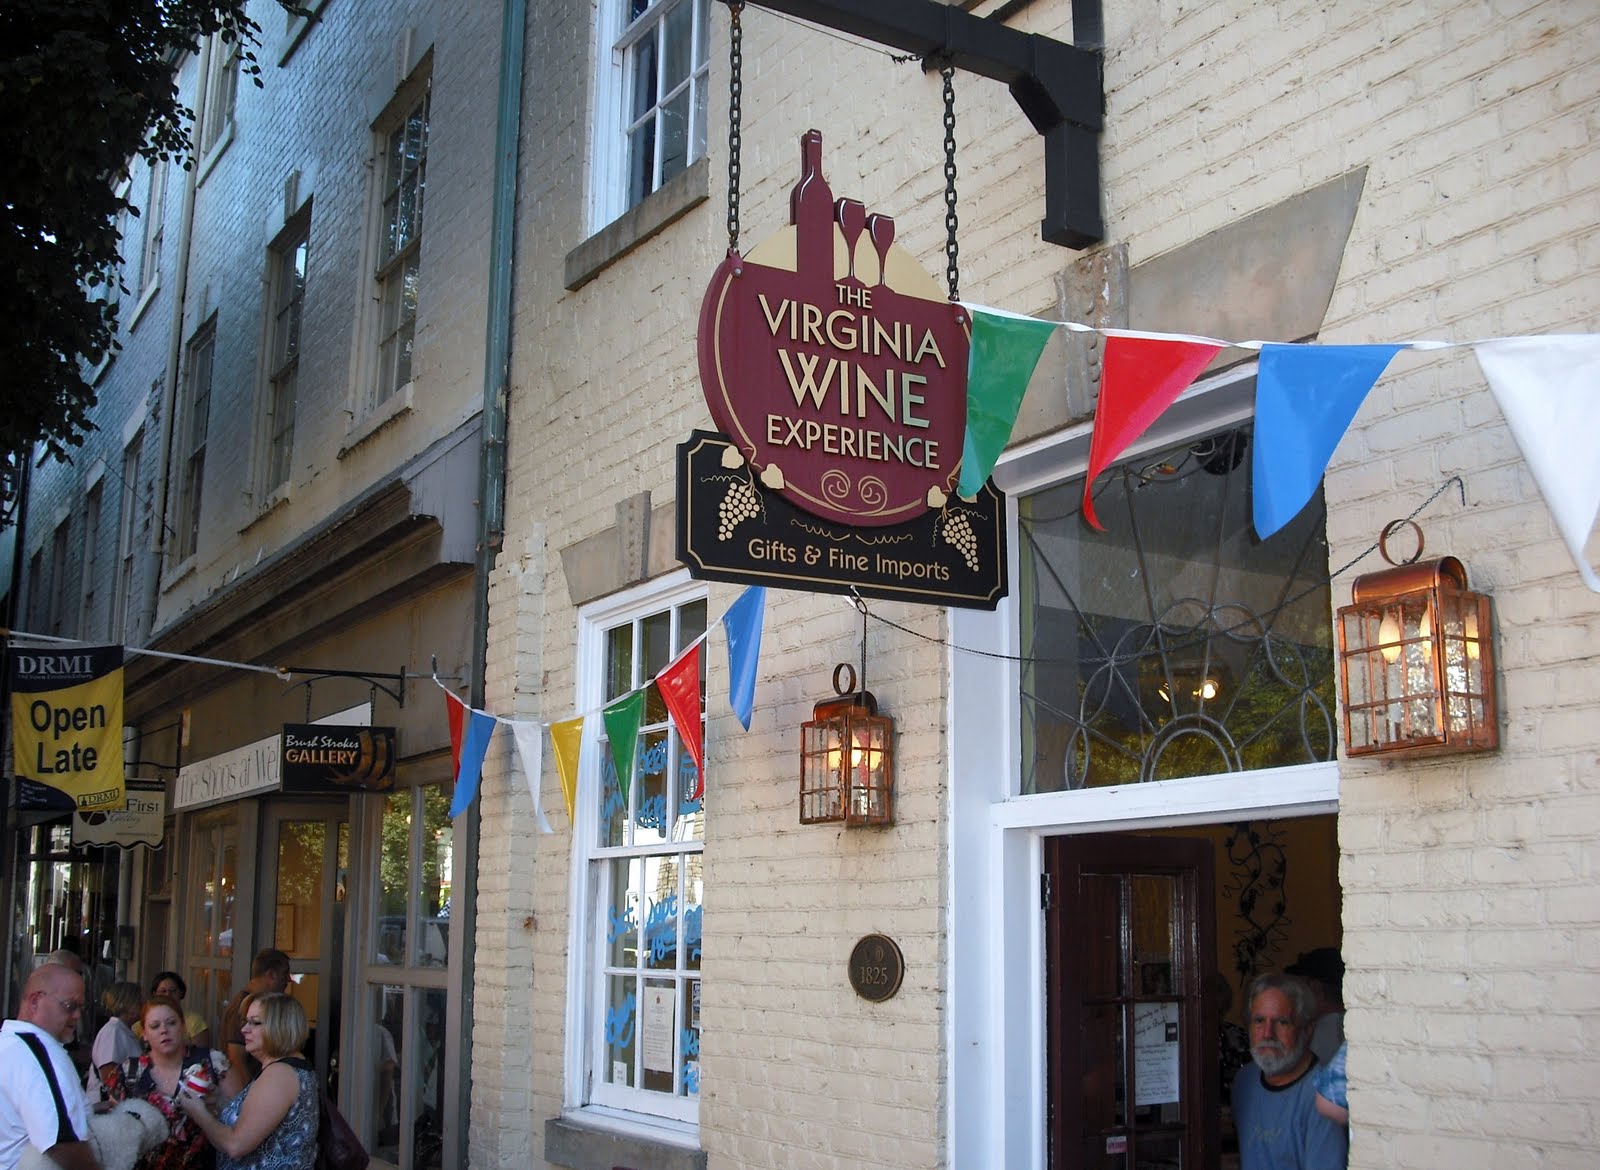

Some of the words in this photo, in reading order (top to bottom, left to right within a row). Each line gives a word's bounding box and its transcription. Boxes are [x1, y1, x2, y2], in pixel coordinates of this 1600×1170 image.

[835, 283, 873, 310] THE
[757, 294, 947, 369] VIRGINIA
[777, 348, 931, 429] WINE
[766, 414, 941, 470] EXPERIENCE
[748, 538, 797, 564] Gifts
[804, 544, 822, 566] &
[829, 548, 869, 571] Fine
[876, 554, 951, 582] Imports
[17, 655, 93, 675] DRMI
[30, 699, 106, 740] Open
[286, 734, 318, 748] Brush
[320, 736, 359, 749] Strokes
[37, 742, 98, 773] Late
[285, 749, 358, 765] GALLERY
[88, 791, 116, 803] DRMI
[126, 798, 159, 812] First
[860, 966, 888, 985] 1825
